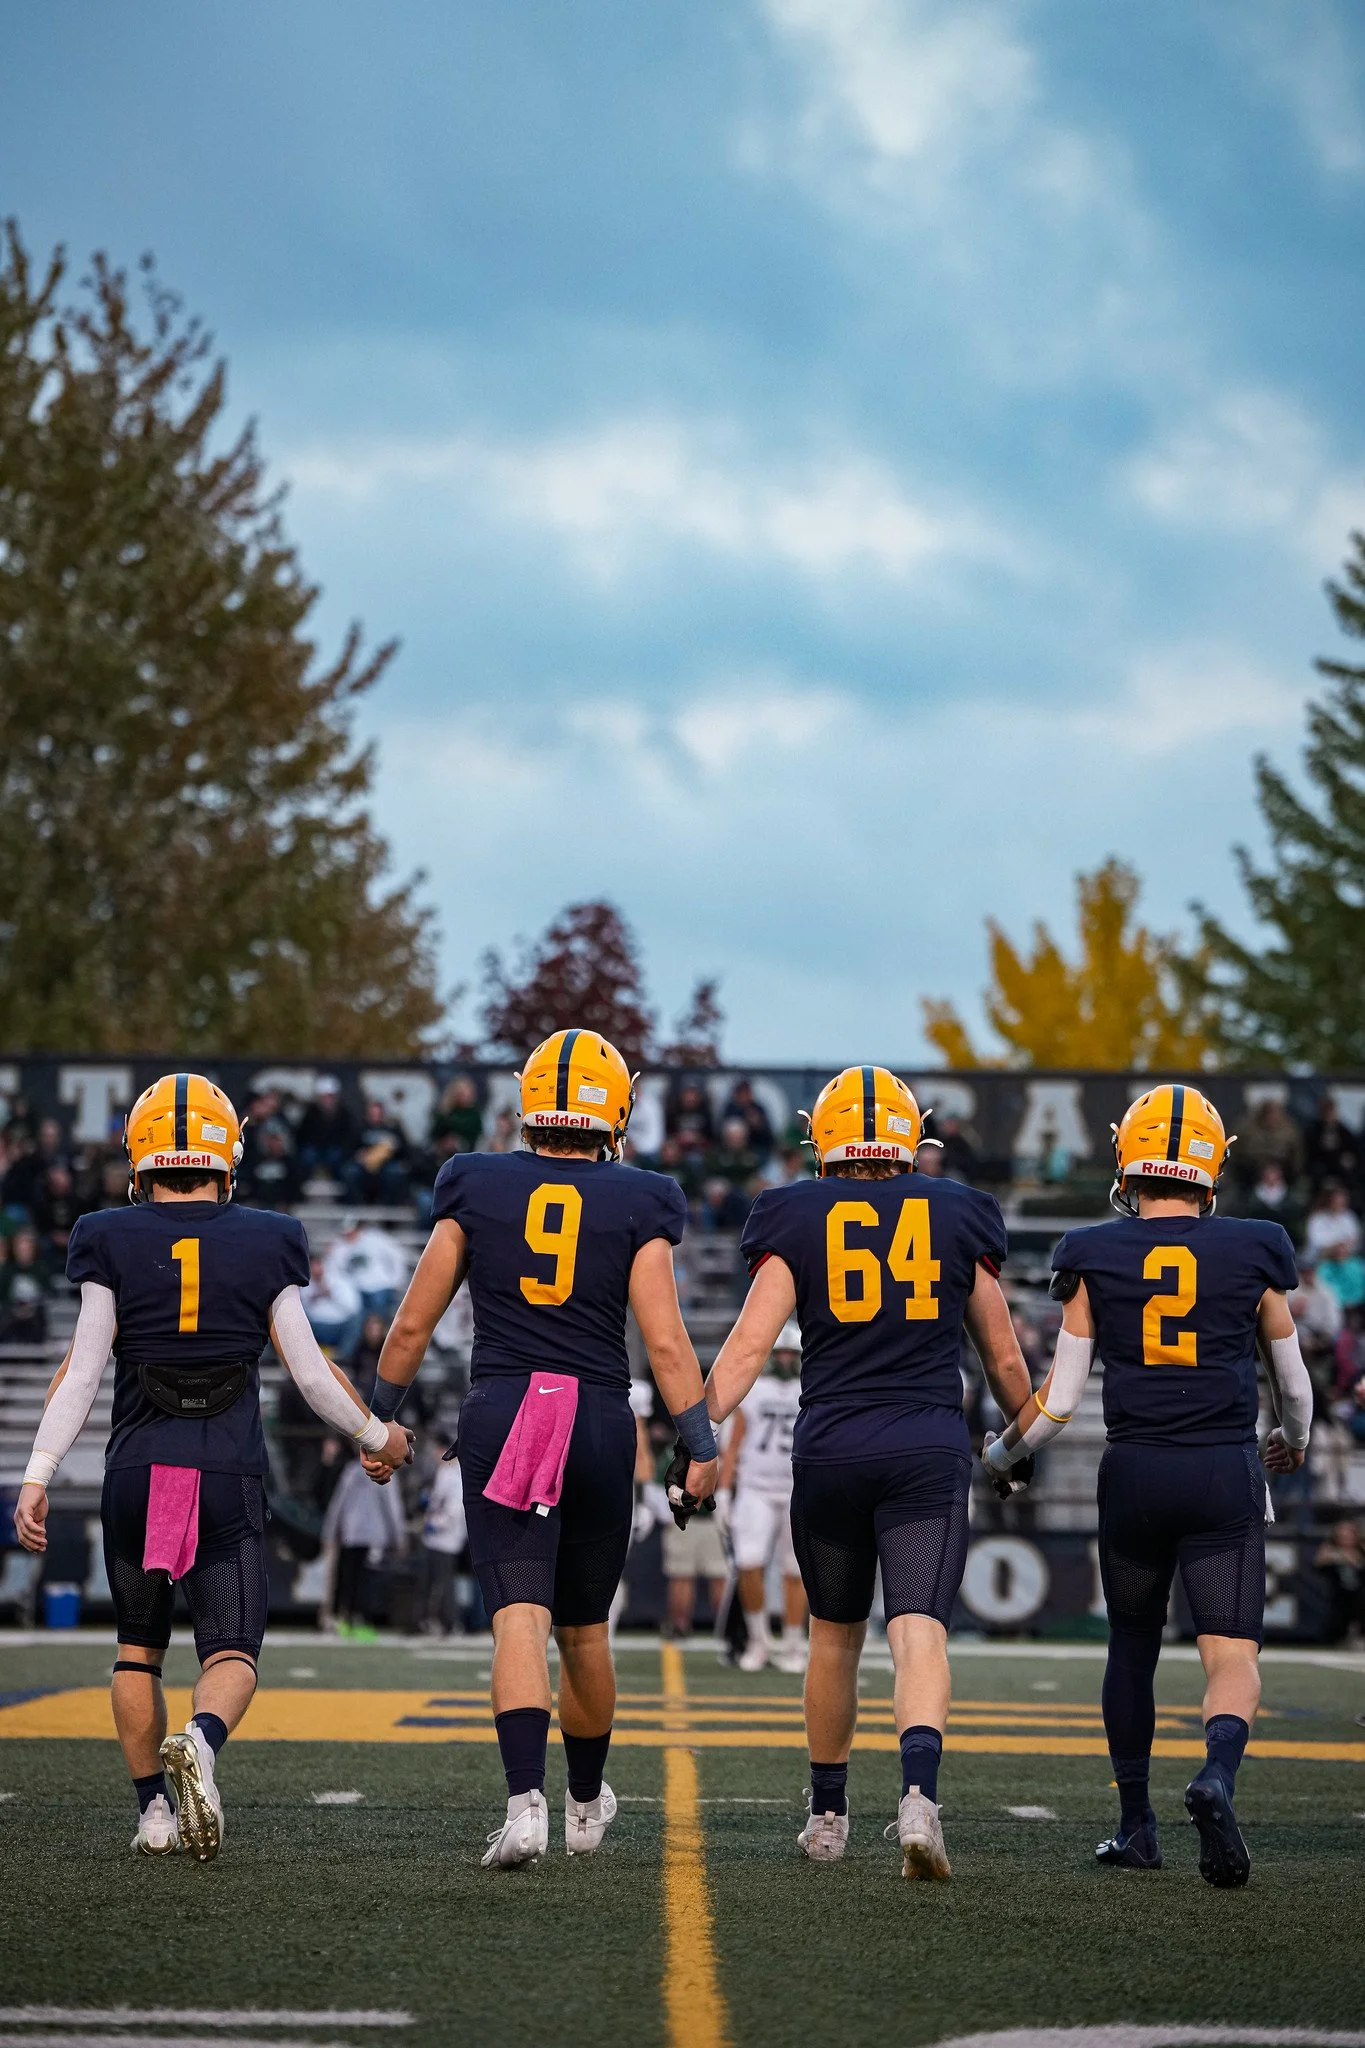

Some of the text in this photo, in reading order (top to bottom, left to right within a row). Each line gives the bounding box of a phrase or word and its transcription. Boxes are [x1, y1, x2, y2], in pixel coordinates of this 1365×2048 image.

[535, 1114, 591, 1128] Riddell
[154, 1155, 211, 1166] Riddell
[845, 1145, 900, 1159] Riddell
[1142, 1162, 1199, 1181] Riddell
[519, 1184, 583, 1306] 9
[826, 1197, 941, 1323] 64
[171, 1238, 200, 1333] 1
[1142, 1245, 1198, 1368] 2
